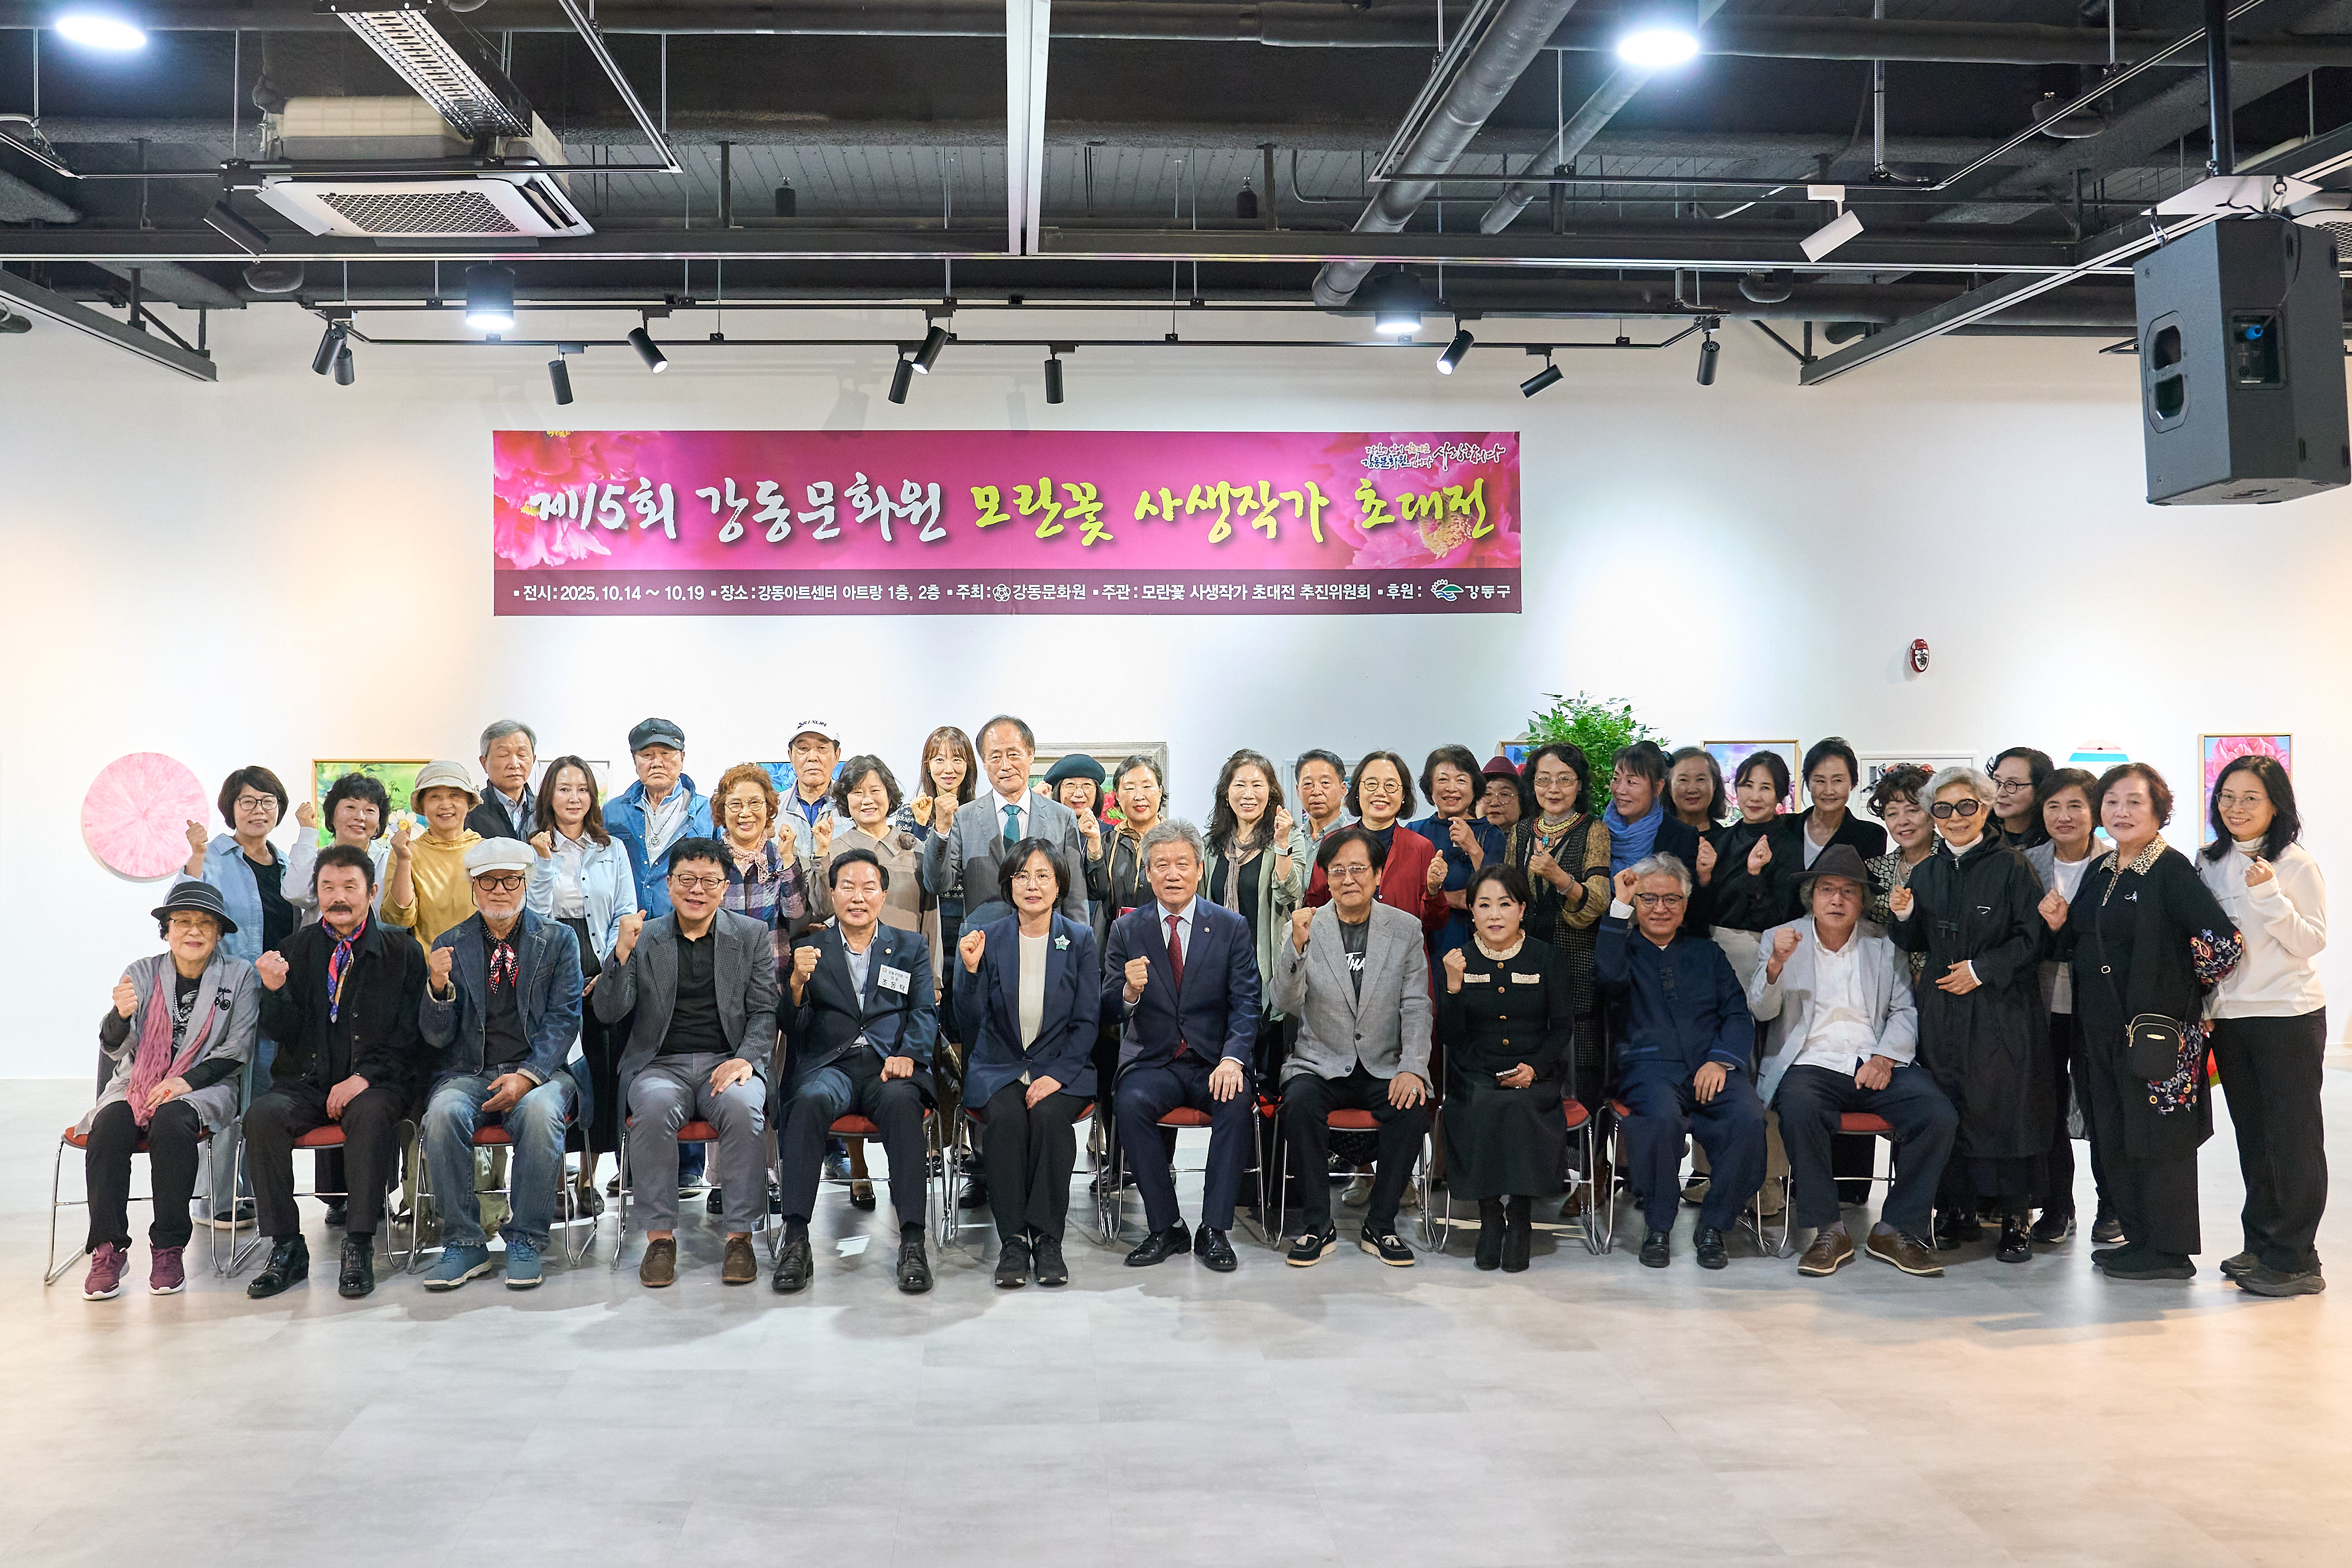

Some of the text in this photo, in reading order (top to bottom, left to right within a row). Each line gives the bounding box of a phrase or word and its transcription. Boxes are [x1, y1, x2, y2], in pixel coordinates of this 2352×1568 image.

[1433, 442, 1506, 471] 사랑합니다
[536, 472, 1495, 546] 제15회 강동문화원 모란꽃 사생작가 초대전
[664, 585, 704, 601] 10.19
[842, 584, 883, 601] 아트랑
[888, 584, 913, 601] 1층,
[918, 584, 941, 600] 2층
[1013, 584, 1086, 600] 강동문화원
[1141, 584, 1185, 601] 모란꽃
[1189, 584, 1248, 601] 사생작가
[1251, 584, 1295, 600] 초대전
[1299, 584, 1371, 600] 추진위원회
[1465, 585, 1511, 599] 강동구
